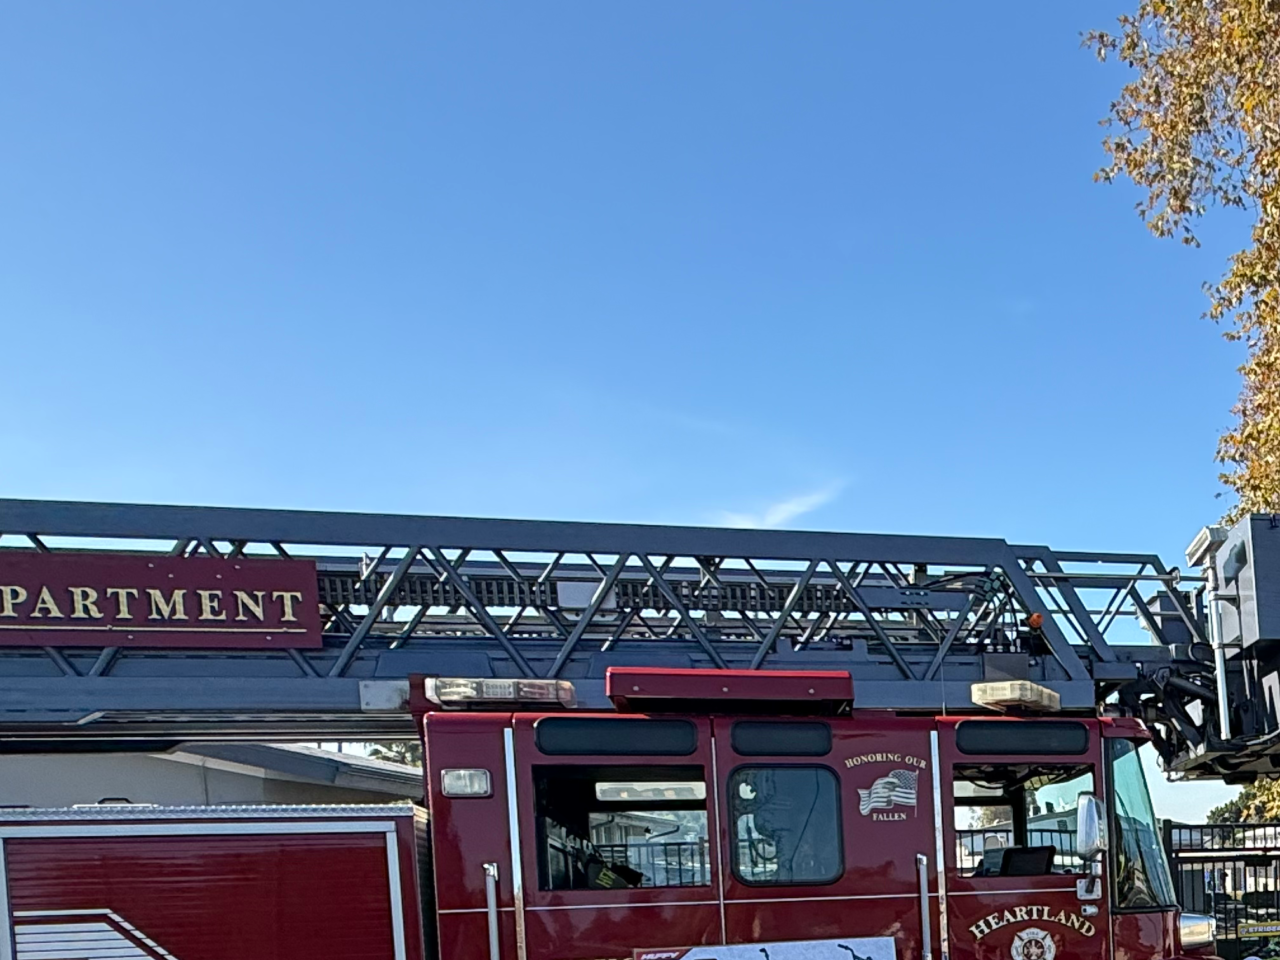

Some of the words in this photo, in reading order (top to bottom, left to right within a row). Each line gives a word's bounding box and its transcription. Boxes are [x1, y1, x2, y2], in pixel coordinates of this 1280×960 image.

[844, 753, 901, 769] HONORING
[905, 755, 926, 769] OUR
[872, 813, 906, 821] FALLEN
[969, 905, 1096, 940] HEARTLAND
[640, 952, 680, 960] HUFFY
